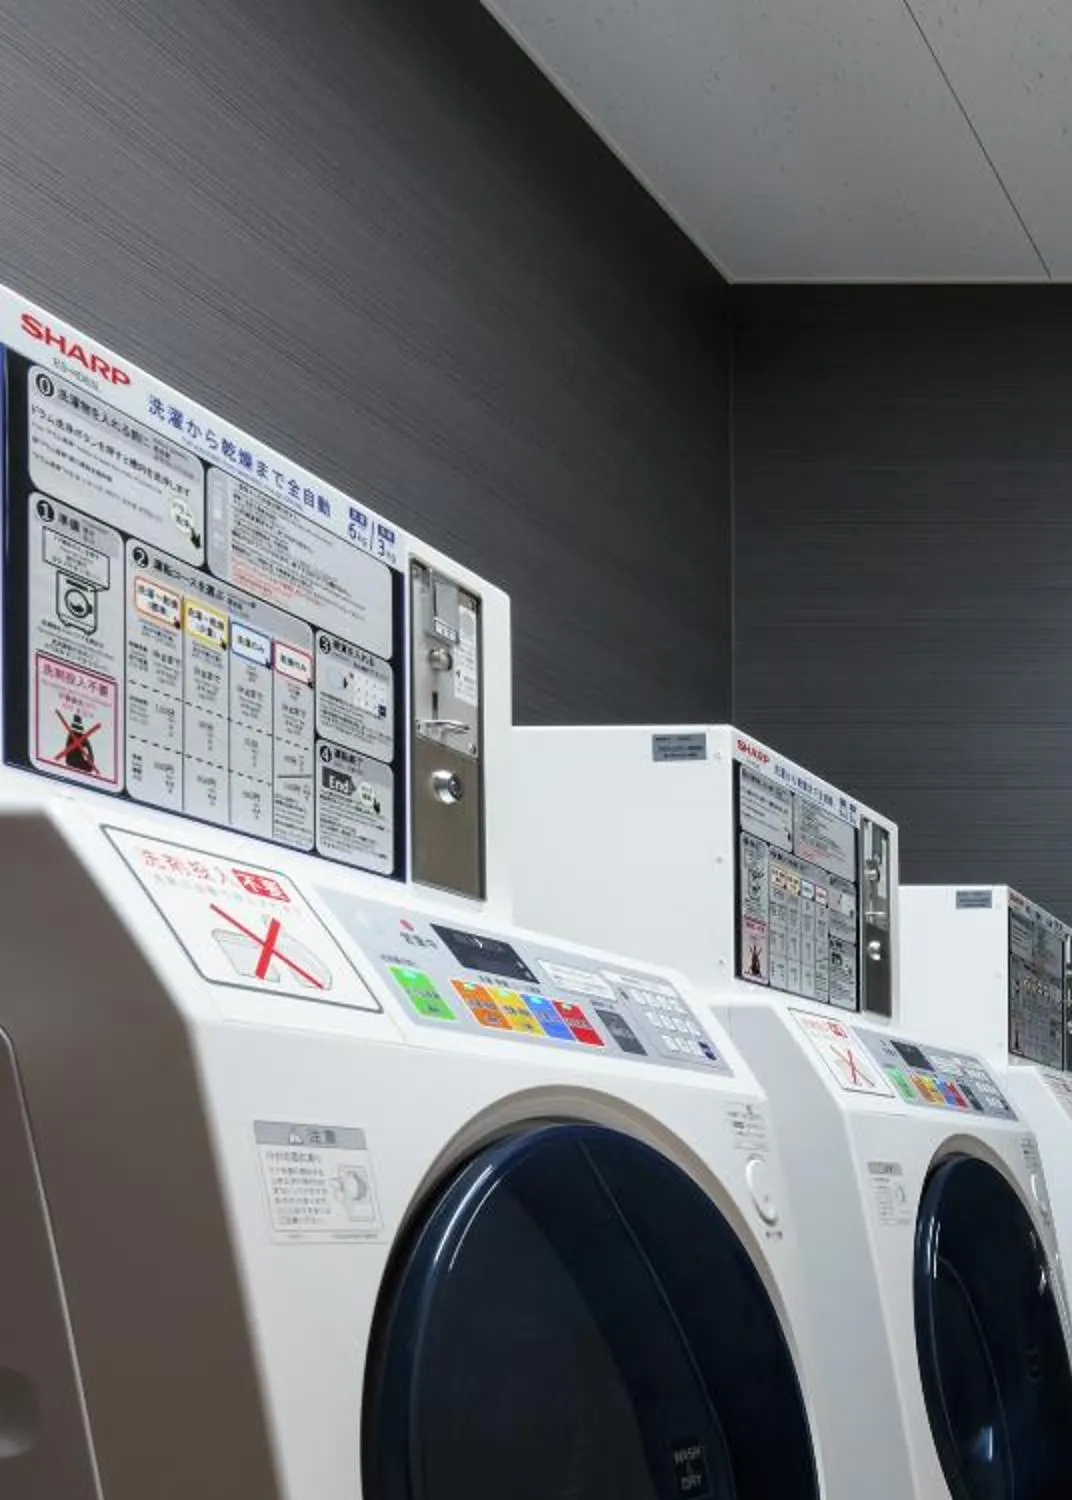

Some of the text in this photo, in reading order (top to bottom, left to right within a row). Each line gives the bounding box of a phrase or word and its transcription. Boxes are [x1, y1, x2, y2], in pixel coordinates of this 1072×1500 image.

[21, 313, 131, 386] SHARP
[146, 393, 332, 519] 洗濯から乾燥まで全自動
